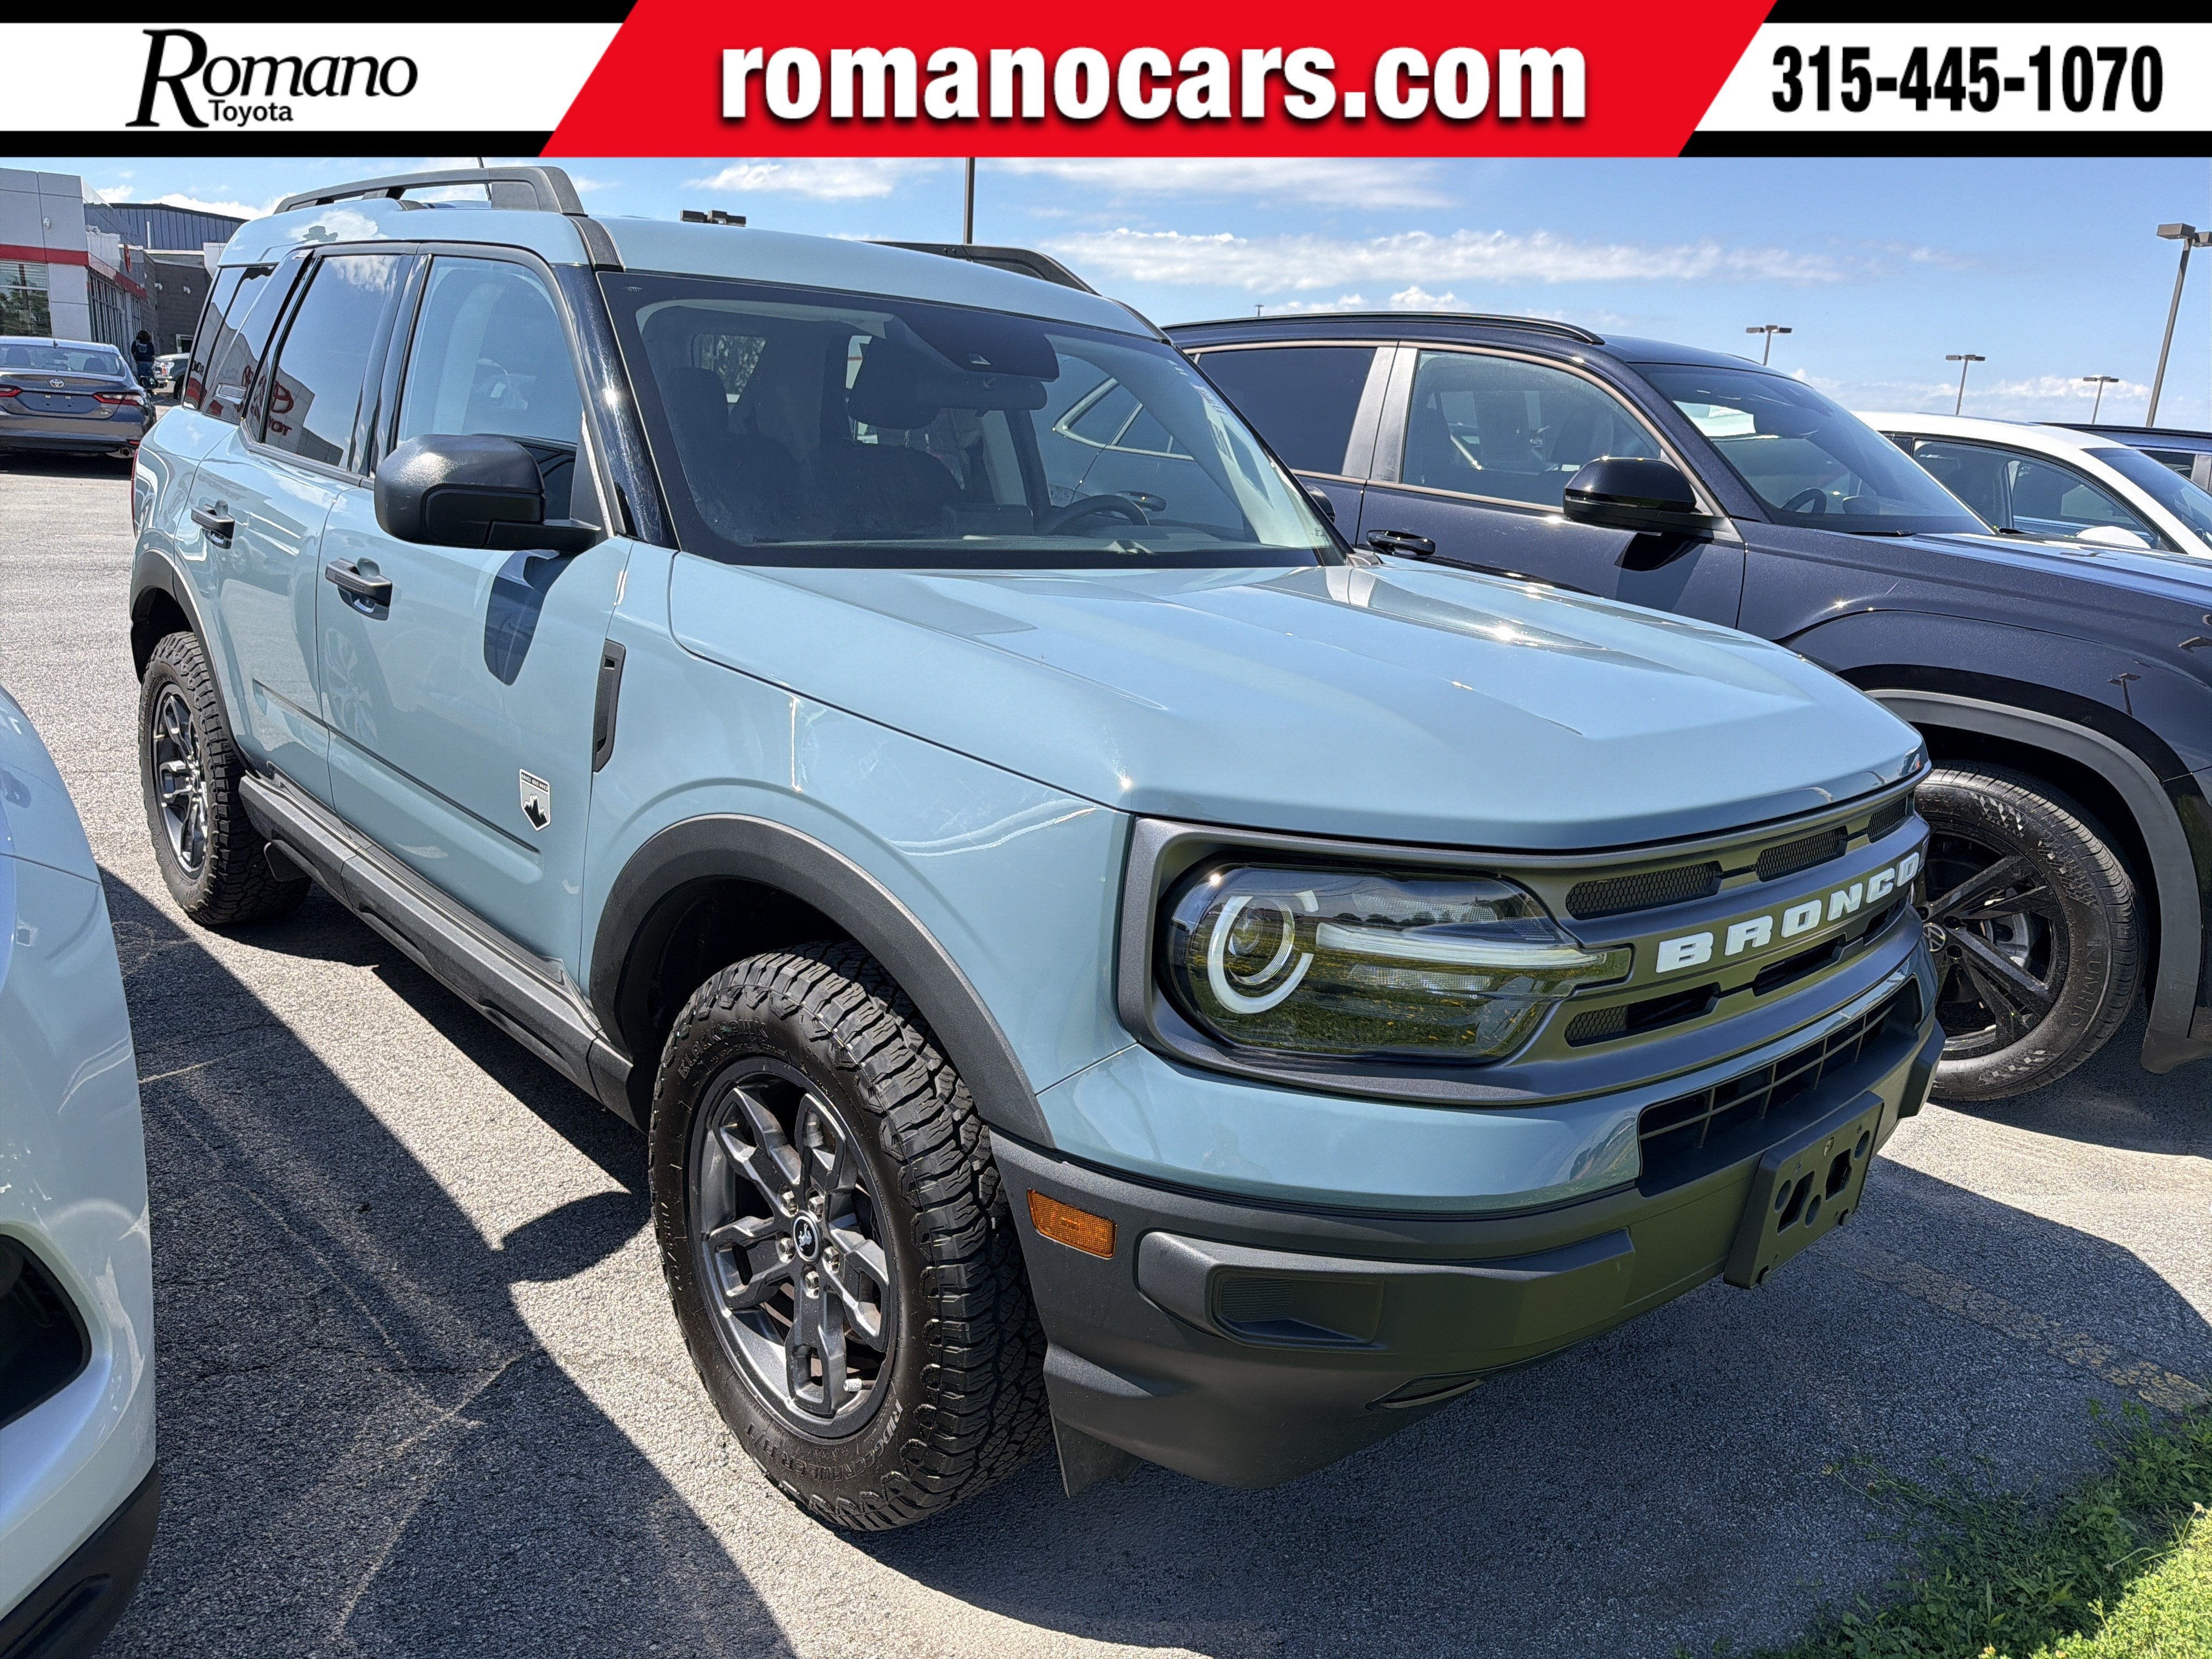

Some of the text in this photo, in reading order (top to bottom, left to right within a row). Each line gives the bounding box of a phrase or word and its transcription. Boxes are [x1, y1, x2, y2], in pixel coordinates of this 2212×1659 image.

[521, 774, 549, 791] BIG BEND
[1655, 851, 1920, 974] BRONCO
[2070, 940, 2102, 1026] KUMHO
